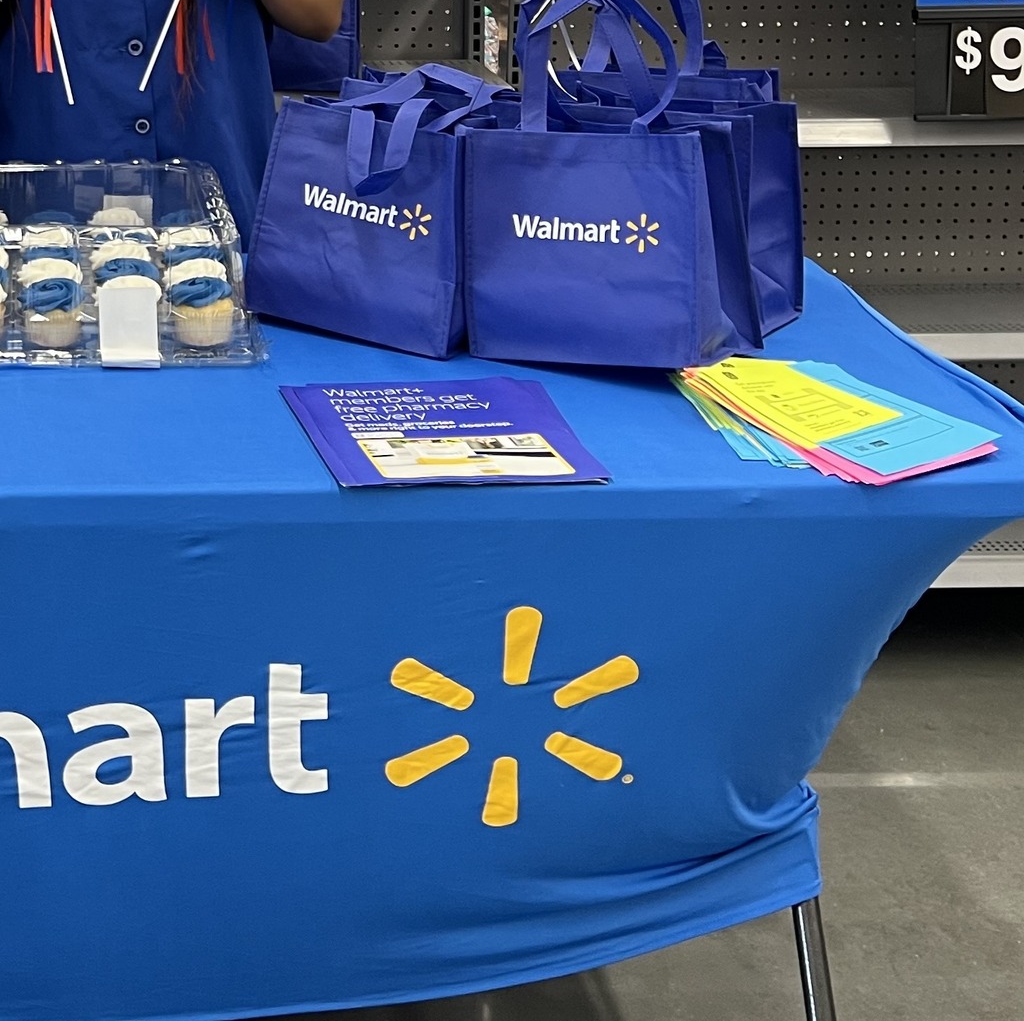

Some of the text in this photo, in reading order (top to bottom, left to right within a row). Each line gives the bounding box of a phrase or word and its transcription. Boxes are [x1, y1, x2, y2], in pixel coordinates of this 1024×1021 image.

[303, 183, 398, 228] Walmart
[512, 213, 620, 244] Walmart
[322, 387, 424, 397] Walmart+
[329, 393, 477, 405] members get
[335, 401, 490, 414] free pharmacy
[340, 412, 426, 422] delivery
